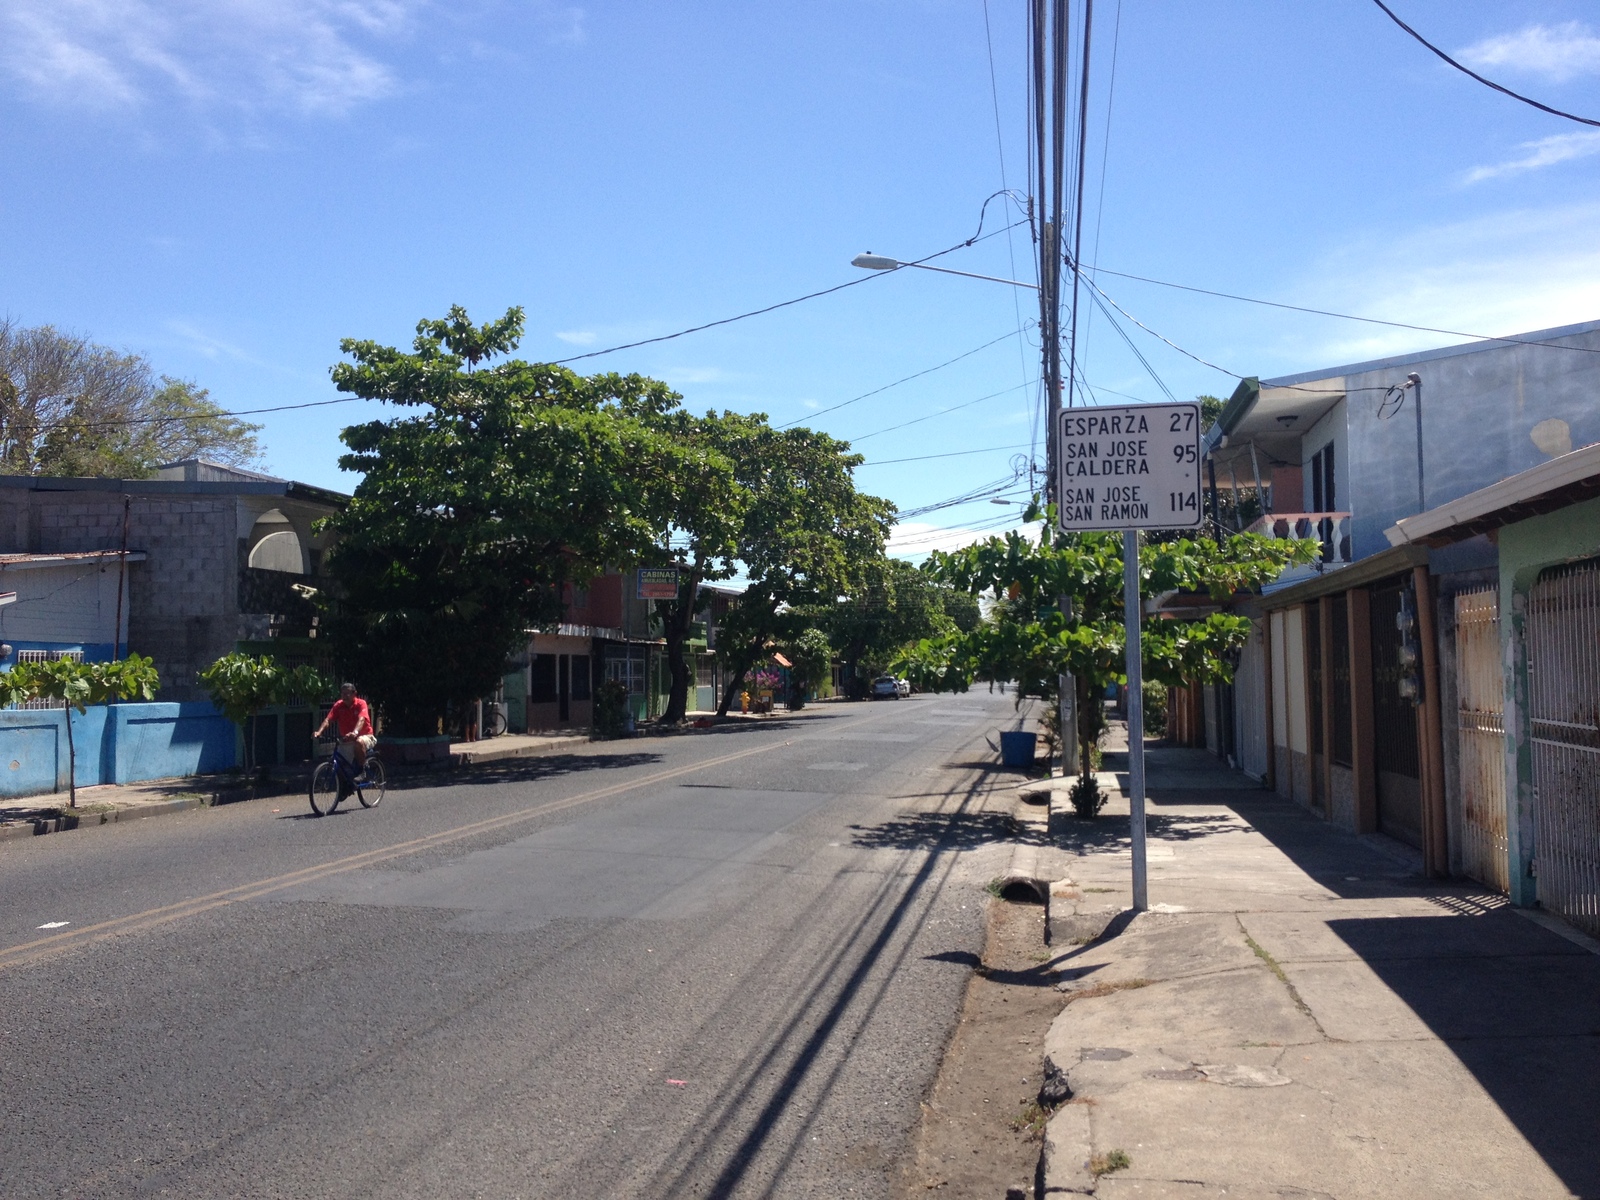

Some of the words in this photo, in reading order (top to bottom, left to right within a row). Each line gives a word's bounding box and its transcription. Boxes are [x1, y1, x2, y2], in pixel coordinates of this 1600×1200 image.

[1064, 414, 1149, 436] ESPARZA
[1169, 412, 1195, 432] 27
[1067, 442, 1098, 459] SAN
[1106, 440, 1147, 457] JOSE
[1173, 444, 1197, 463] 95
[1065, 459, 1150, 477] CALDERA
[1066, 487, 1095, 504] SAN
[1102, 486, 1141, 503] JOSE
[1169, 492, 1197, 511] 114
[1065, 505, 1093, 521] SAN
[1101, 503, 1149, 520] RAMON
